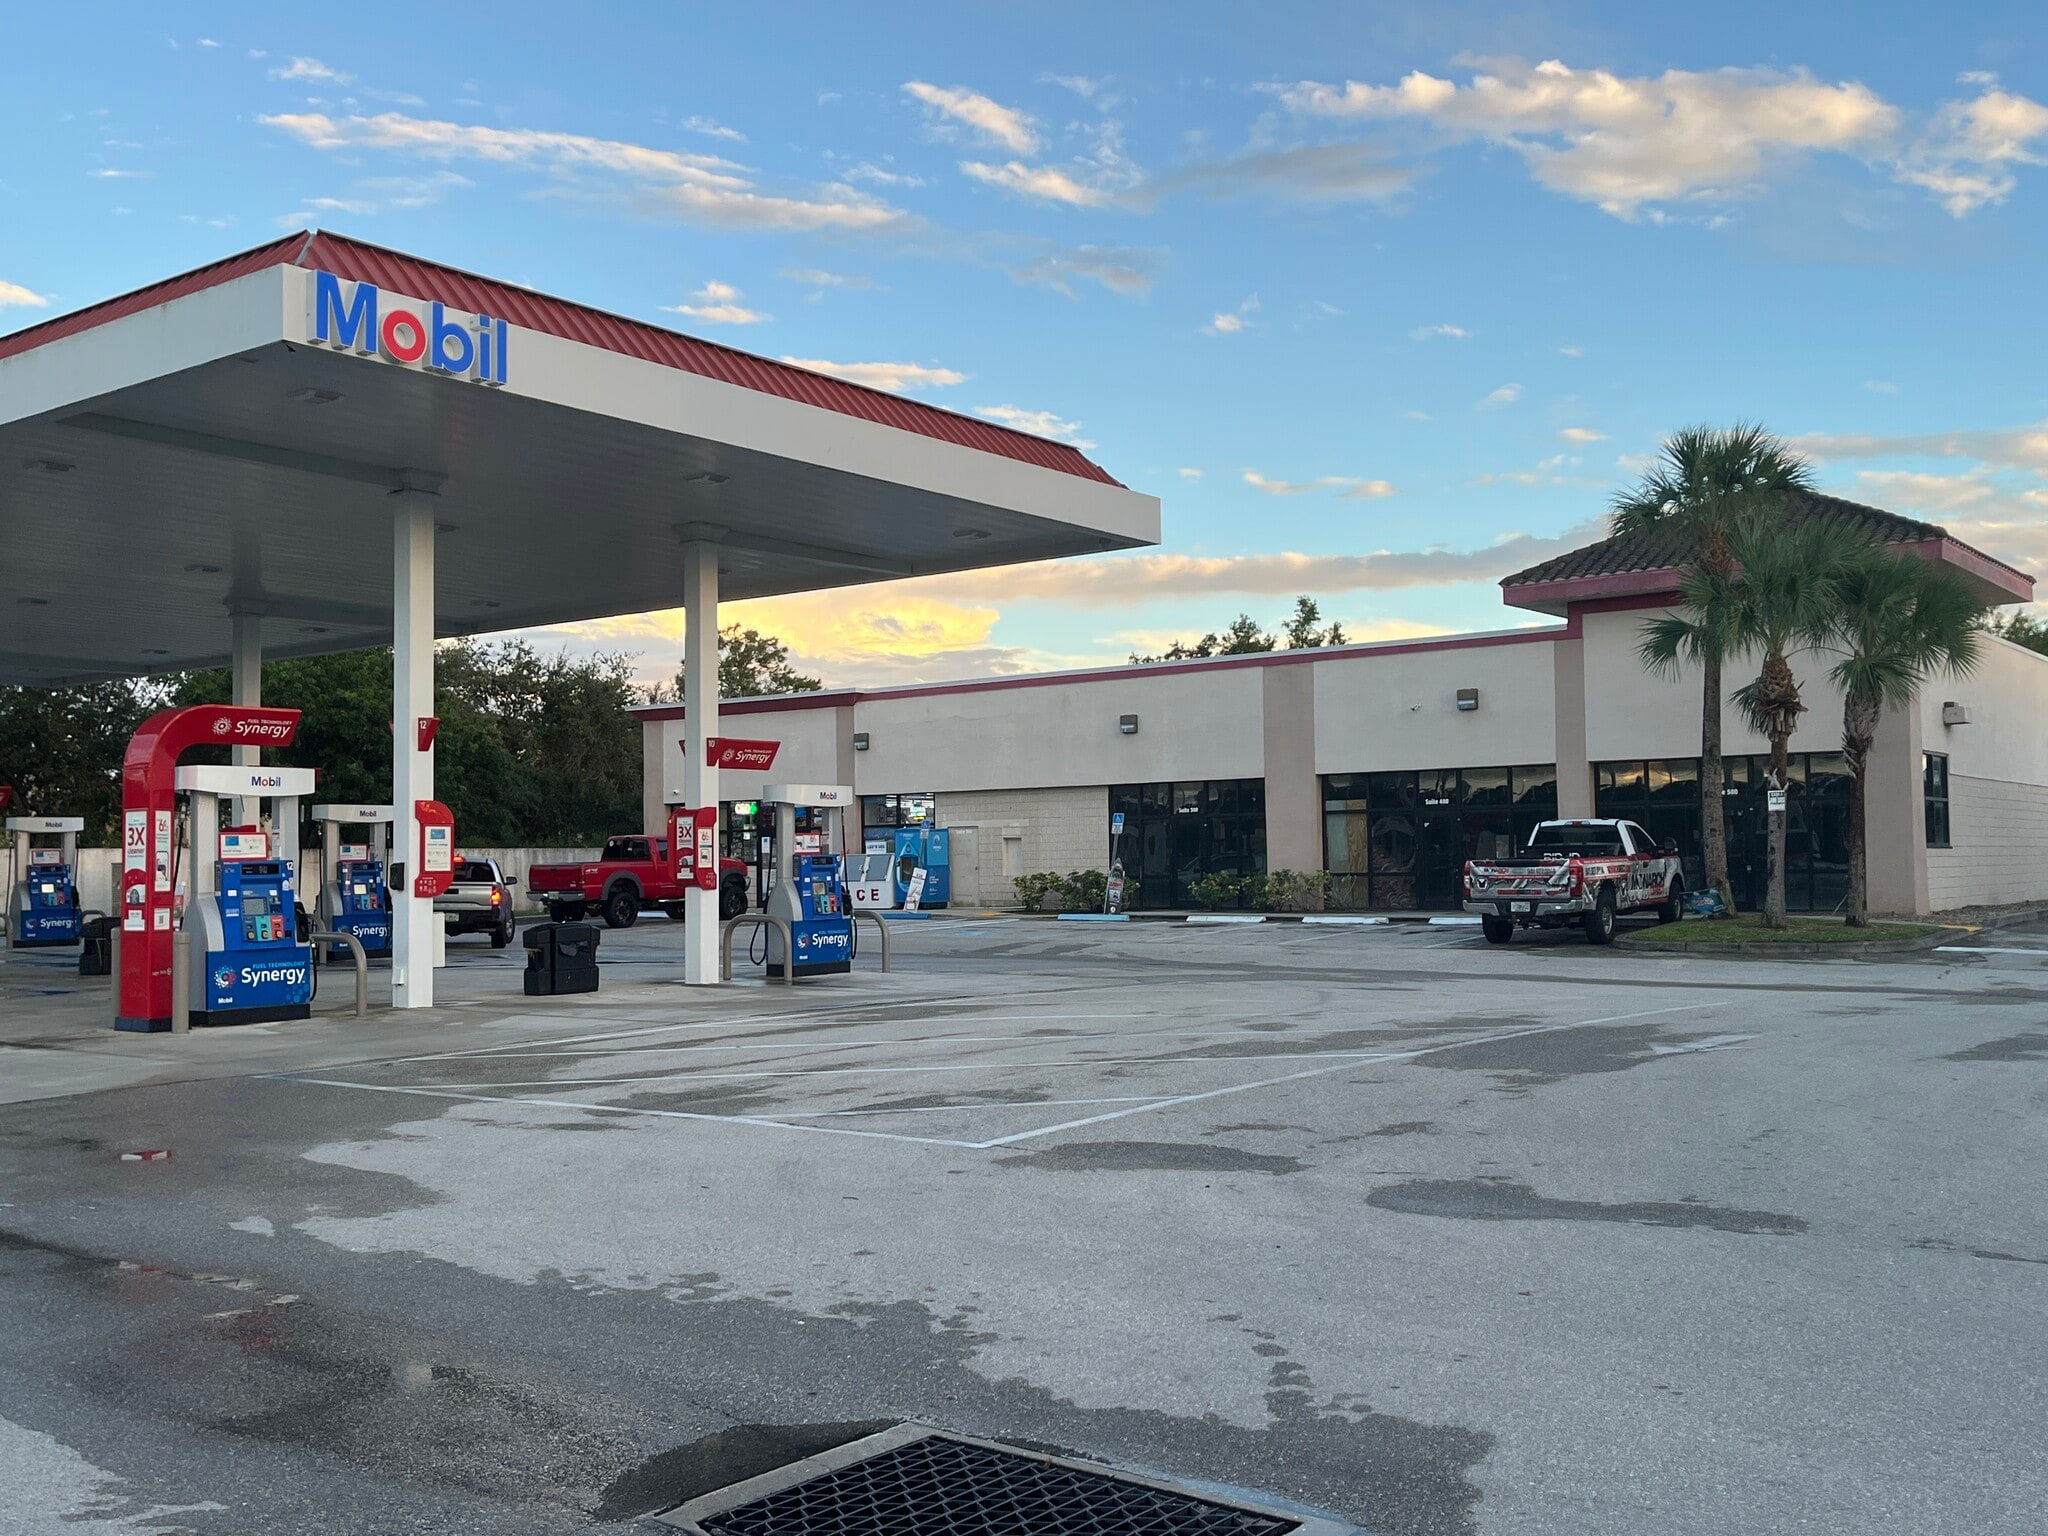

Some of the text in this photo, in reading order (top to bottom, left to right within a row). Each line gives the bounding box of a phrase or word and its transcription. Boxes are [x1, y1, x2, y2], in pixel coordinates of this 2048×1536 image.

[312, 269, 508, 386] Mobil
[234, 721, 291, 738] Synergy
[419, 720, 427, 729] 12
[708, 740, 715, 748] 10
[735, 750, 770, 763] Synergy
[251, 776, 281, 787] Mobil
[820, 791, 837, 800] Mobil
[127, 826, 145, 846] 3X
[678, 826, 692, 839] 3X
[812, 933, 849, 948] Synergy
[241, 967, 306, 987] Synergy
